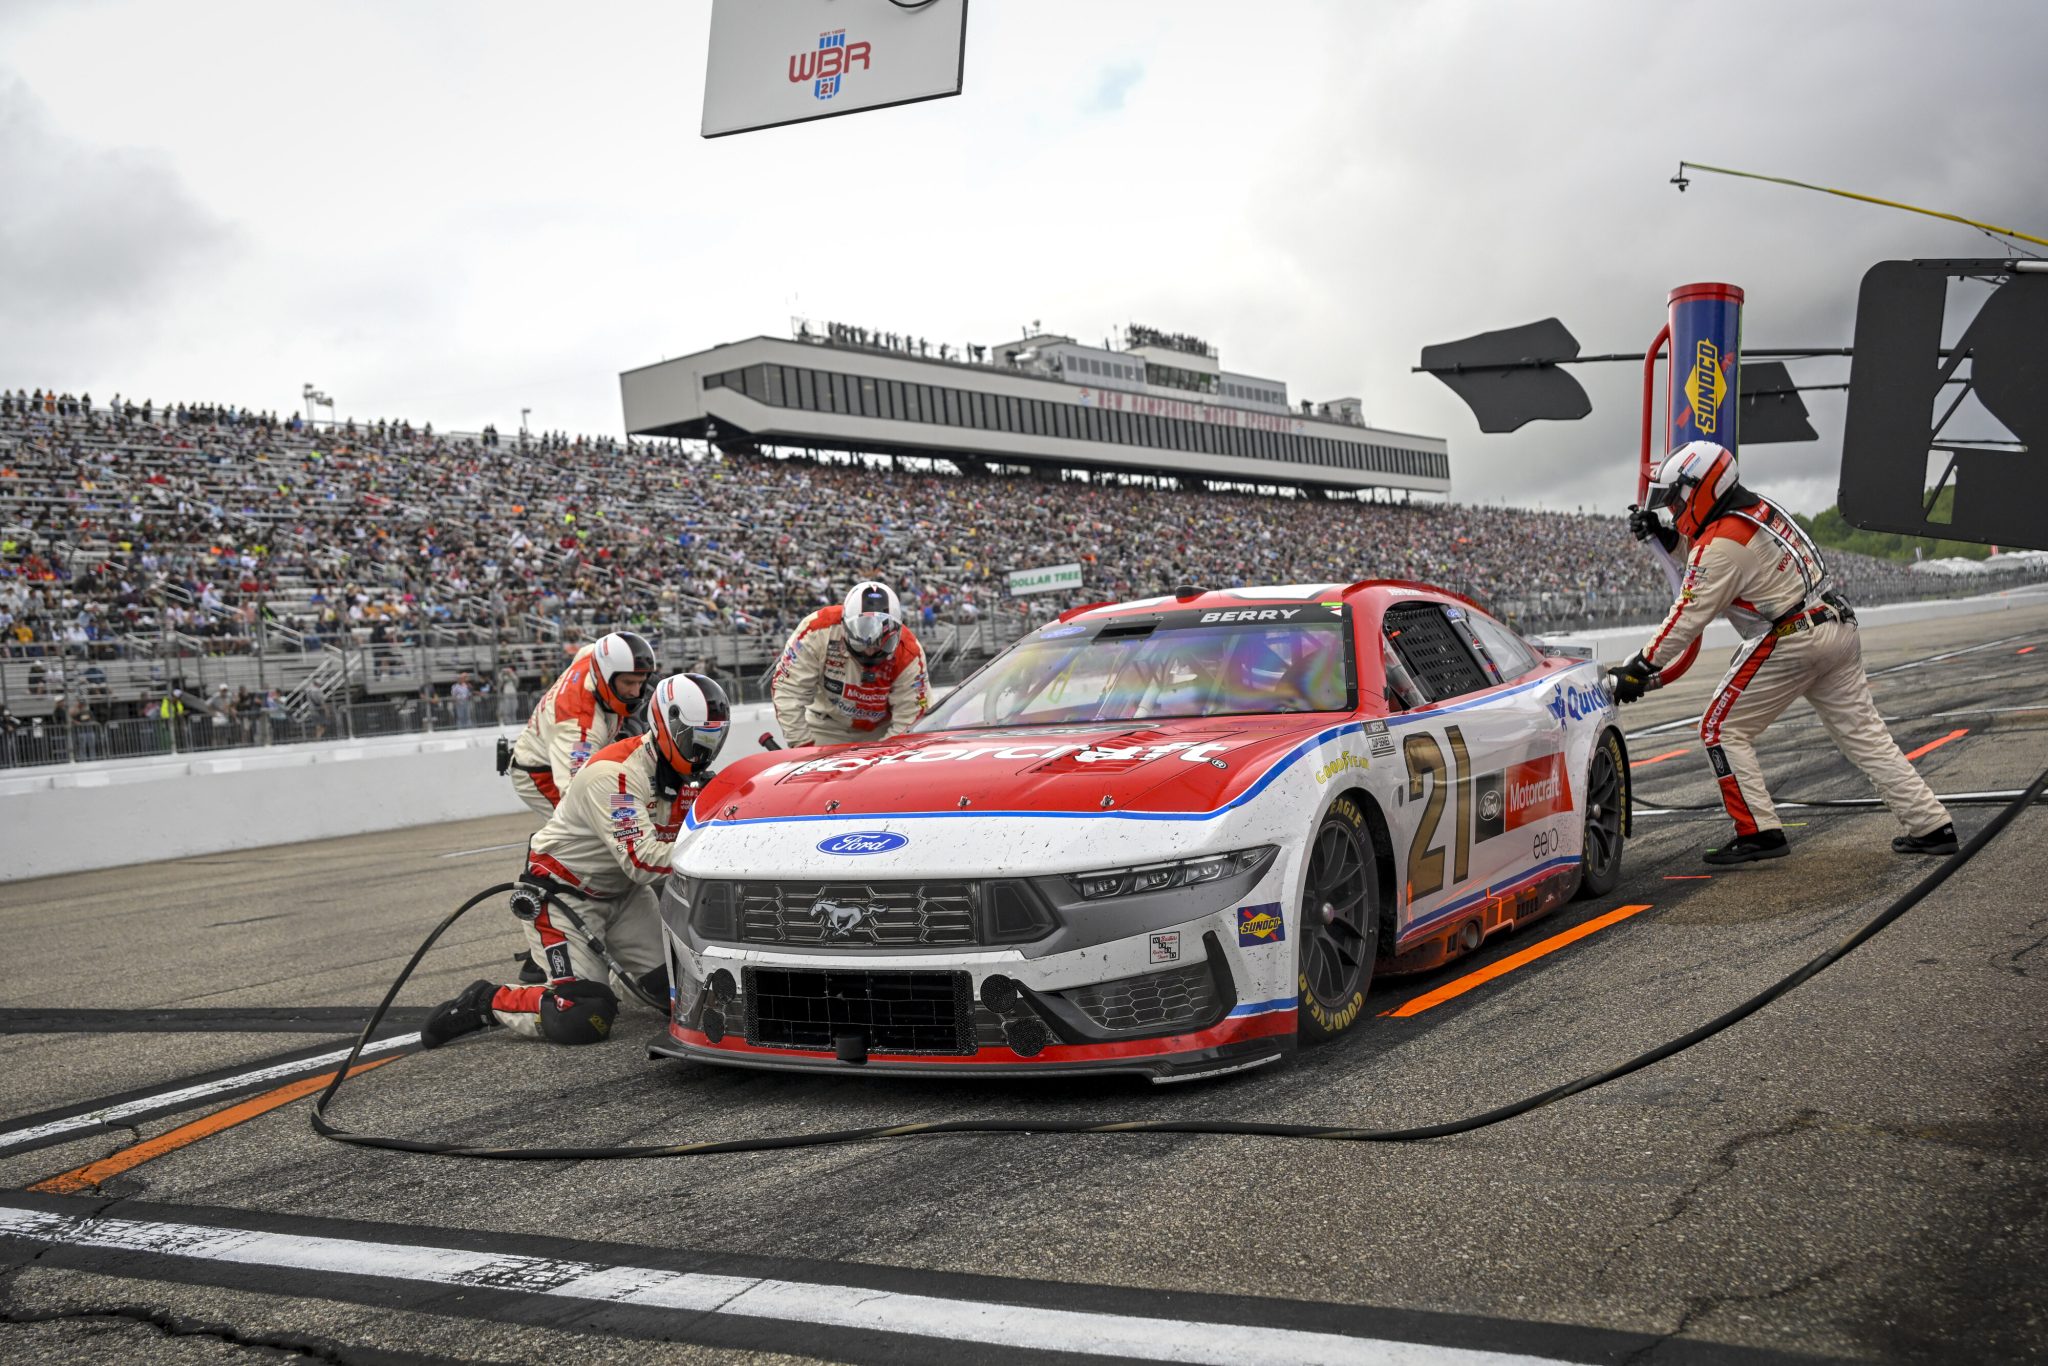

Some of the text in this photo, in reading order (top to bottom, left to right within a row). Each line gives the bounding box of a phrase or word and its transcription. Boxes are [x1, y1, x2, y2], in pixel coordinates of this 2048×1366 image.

[789, 41, 871, 83] WBR
[820, 82, 833, 95] 21
[1697, 343, 1716, 429] SUNOCO
[1010, 570, 1079, 588] DOLLAR TREE
[1200, 609, 1301, 623] BERRY
[1316, 751, 1370, 784] GOODYEAR
[1482, 794, 1498, 817] Ford
[1510, 770, 1560, 812] Motorcraft
[1329, 799, 1363, 828] EAGLE
[1403, 725, 1471, 906] 21
[832, 834, 892, 851] Ford
[1533, 827, 1559, 859] eero
[1242, 917, 1280, 933] SUNOCO
